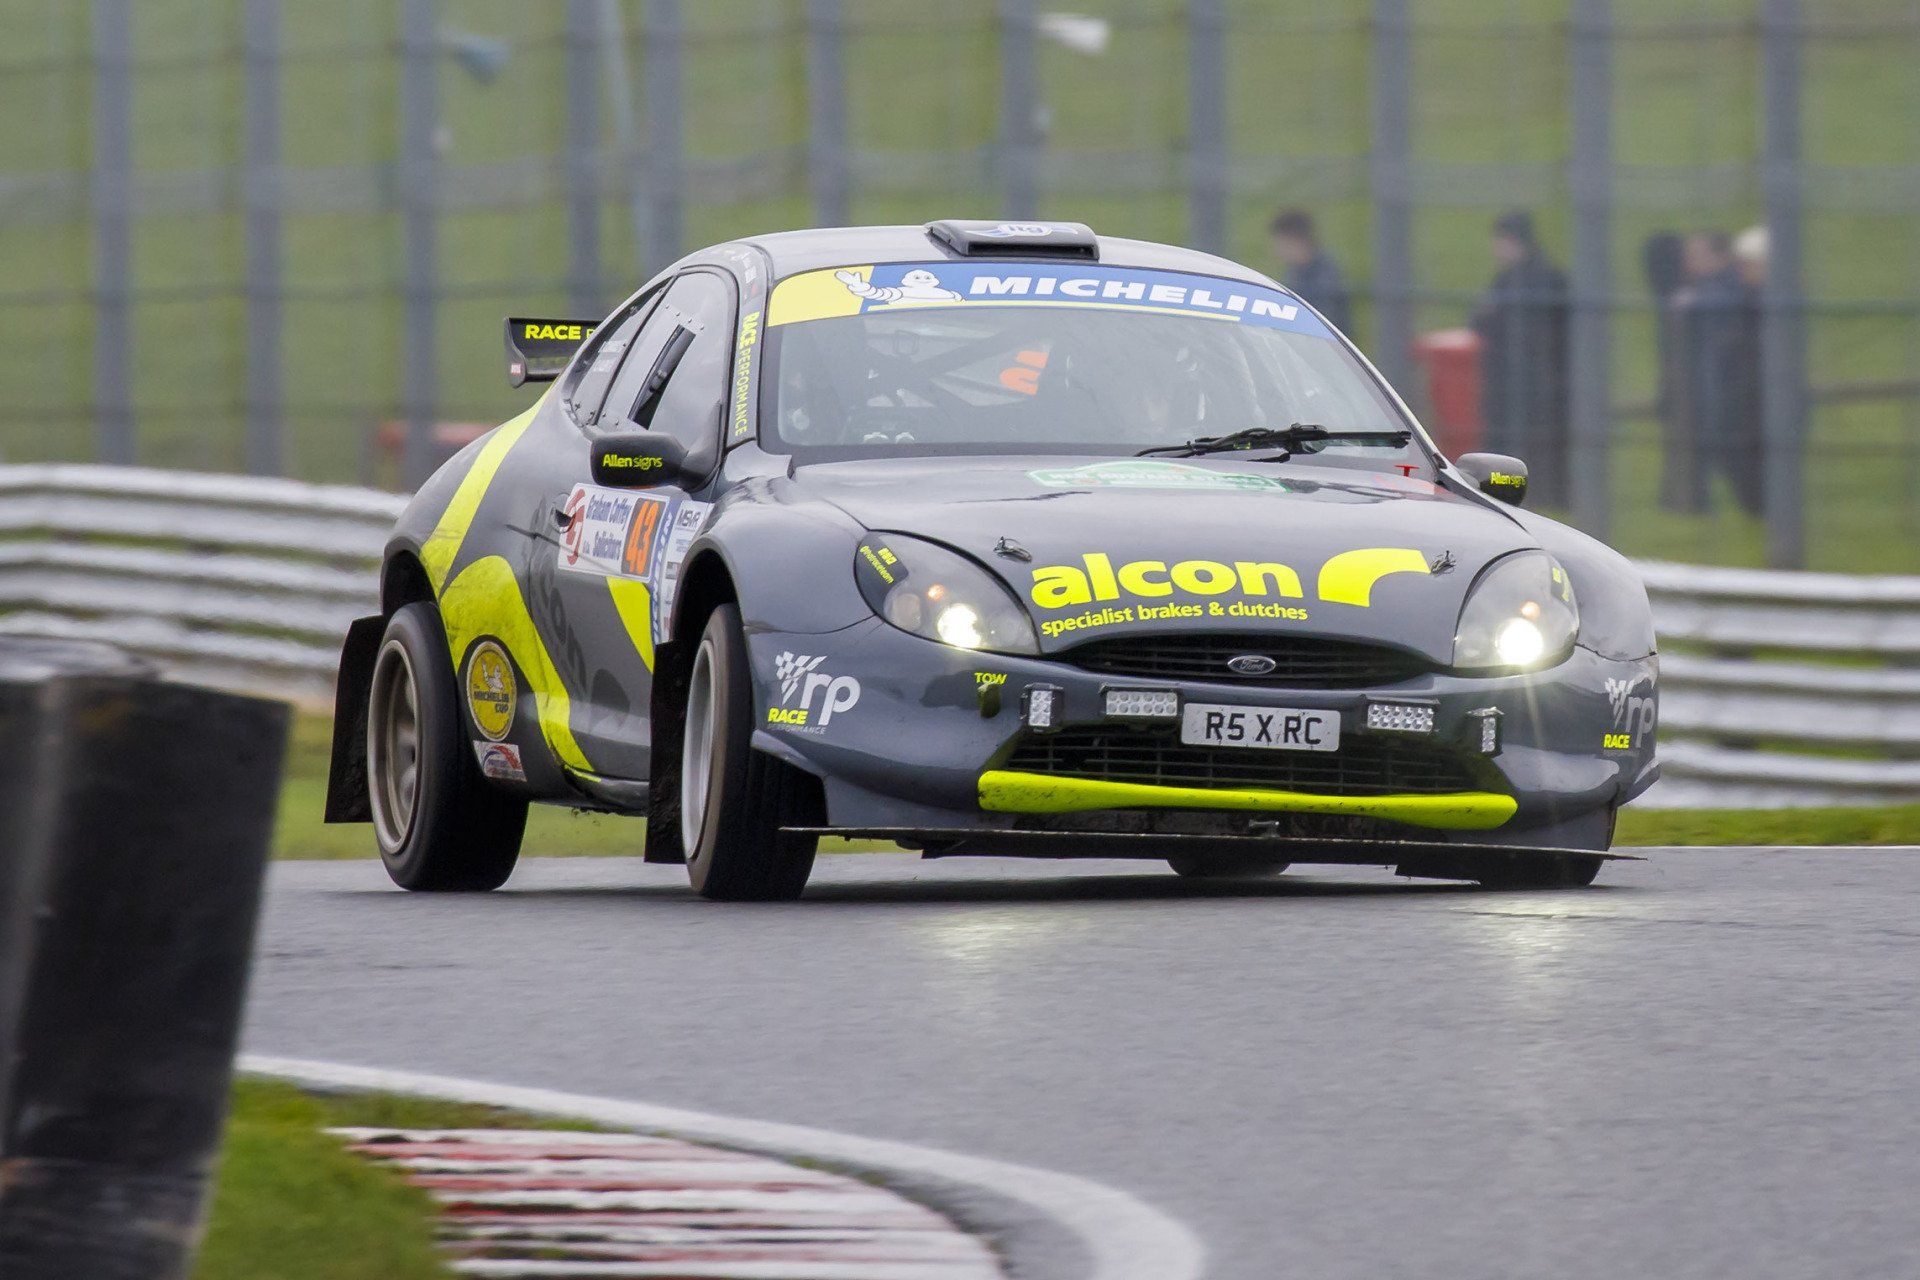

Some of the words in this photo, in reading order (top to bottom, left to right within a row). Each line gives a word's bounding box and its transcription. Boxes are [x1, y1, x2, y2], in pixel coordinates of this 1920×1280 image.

[969, 275, 1299, 321] MICHELIN
[525, 325, 582, 340] RACE
[739, 311, 760, 348] RACE
[734, 347, 752, 436] PERFORMANCE
[602, 453, 632, 468] Allen
[632, 454, 663, 471] signs
[1490, 471, 1511, 486] Allen
[625, 499, 660, 576] 43
[1030, 552, 1304, 610] alcon
[1040, 606, 1135, 639] specialist
[1138, 602, 1204, 622] brakes
[1208, 601, 1225, 617] &
[1229, 601, 1309, 622] clutches
[974, 671, 1008, 686] TOW
[767, 707, 809, 725] RACE
[1205, 711, 1246, 741] R5
[1603, 733, 1632, 749] RACE
